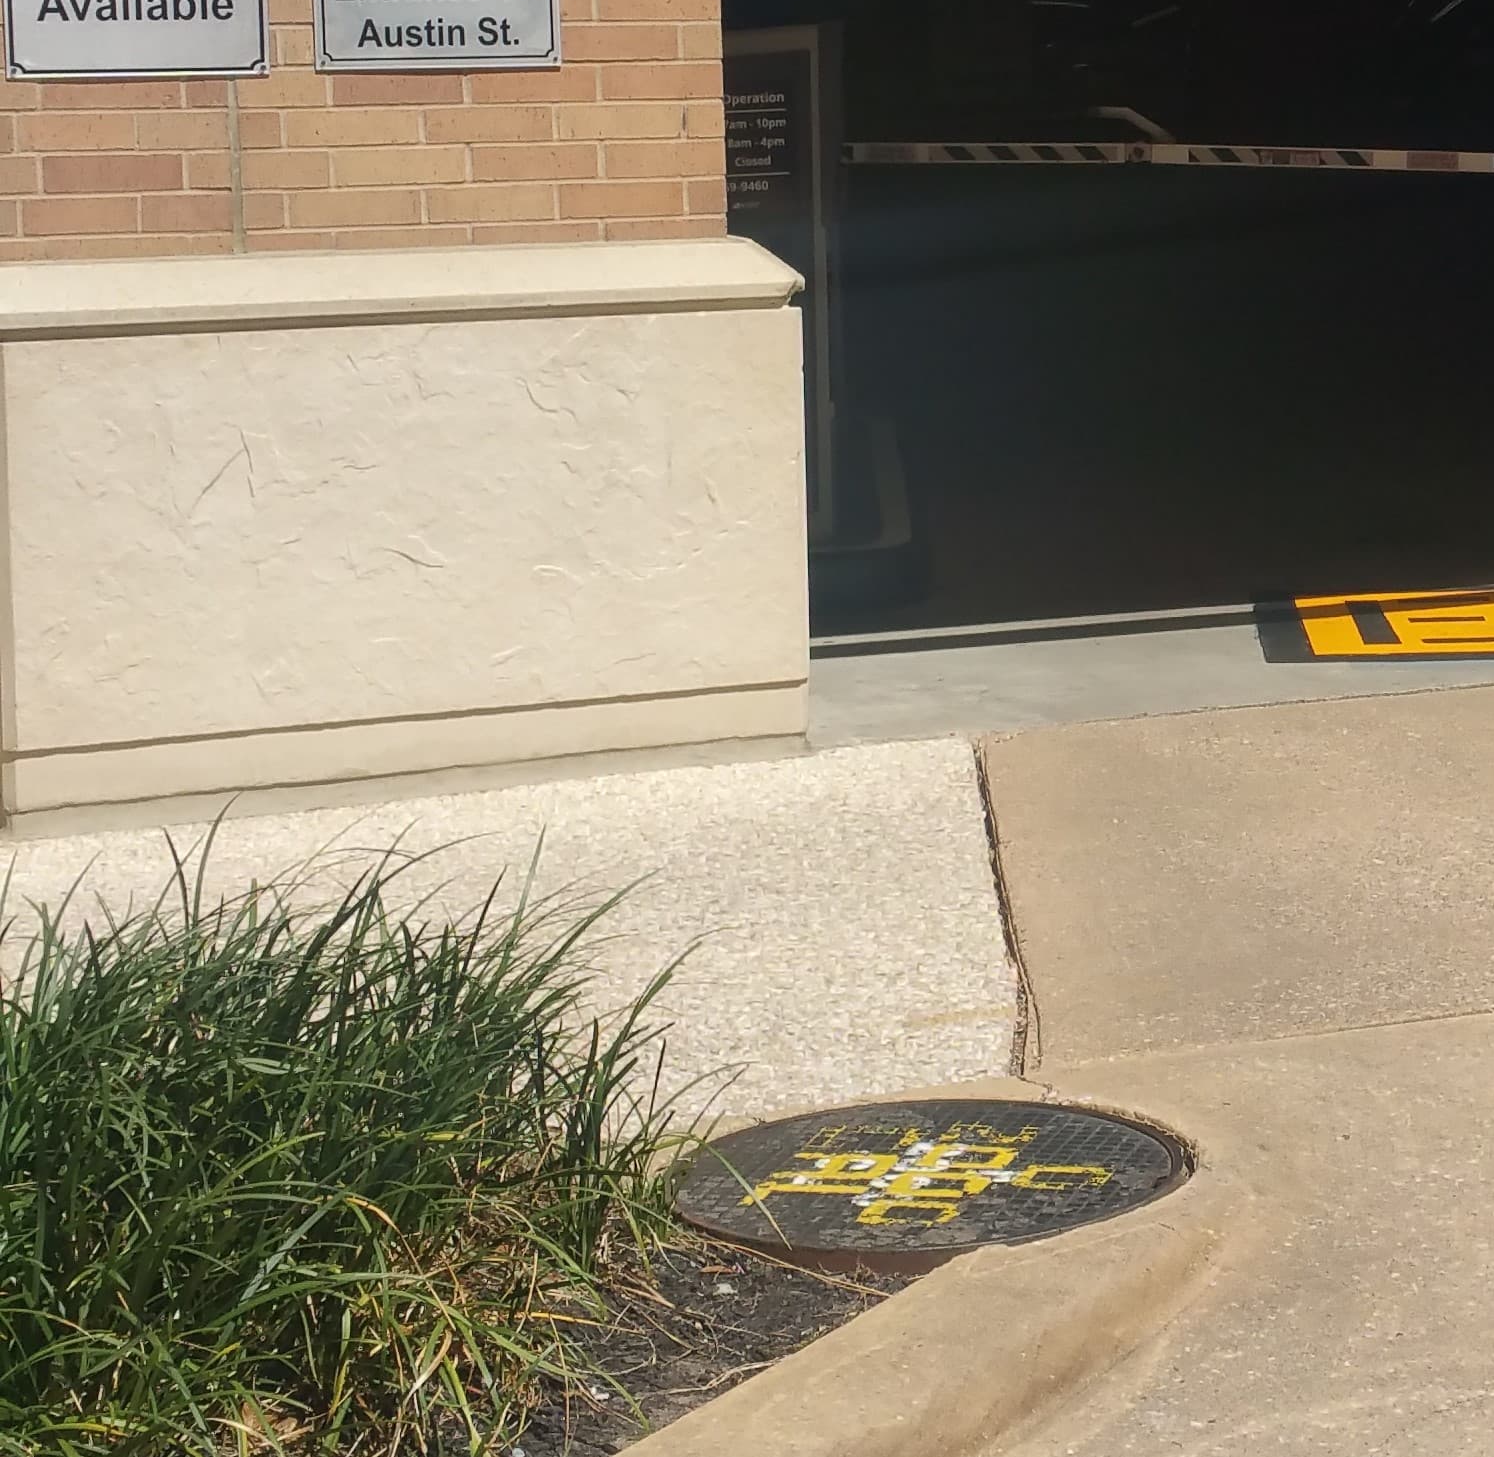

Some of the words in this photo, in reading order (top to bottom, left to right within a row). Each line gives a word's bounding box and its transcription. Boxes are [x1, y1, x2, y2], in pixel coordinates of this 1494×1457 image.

[357, 17, 467, 48] Austin
[478, 17, 521, 47] St.
[757, 118, 787, 130] 10pm
[761, 137, 785, 149] 4pm
